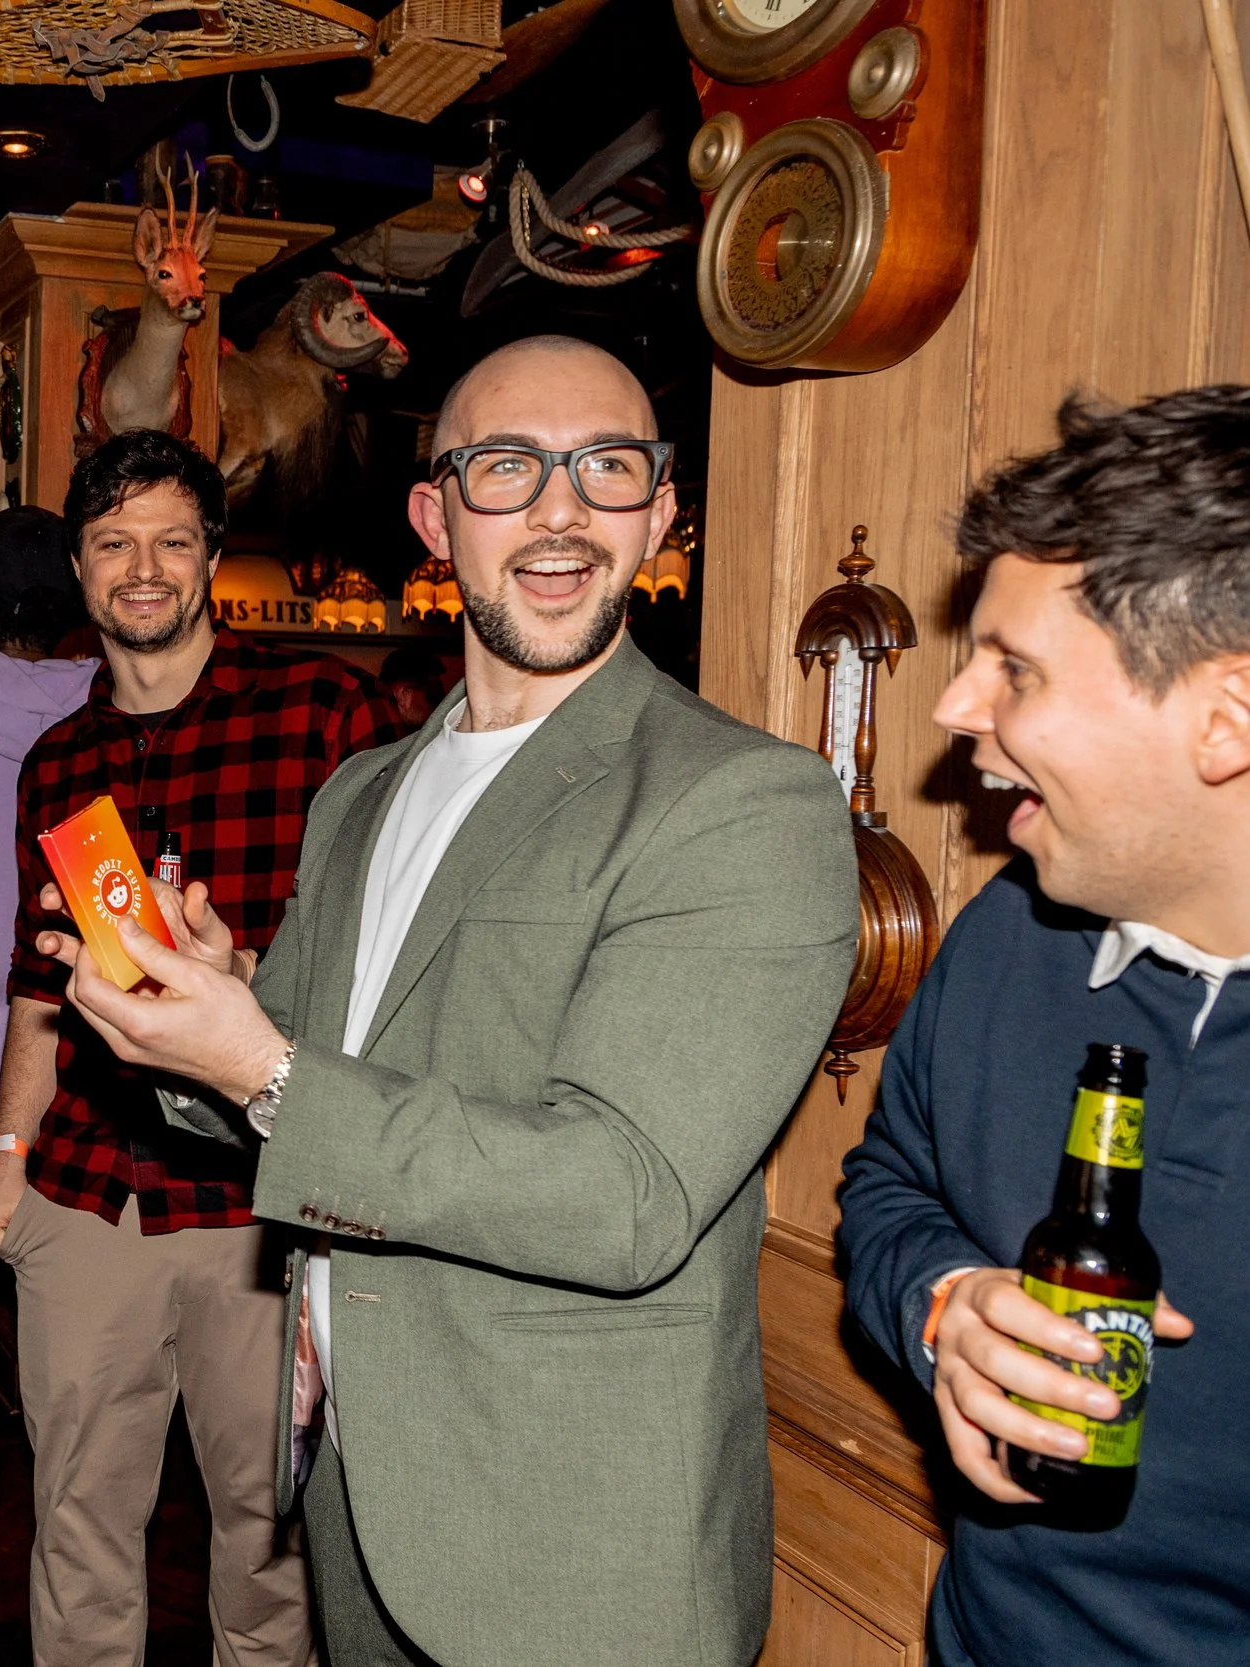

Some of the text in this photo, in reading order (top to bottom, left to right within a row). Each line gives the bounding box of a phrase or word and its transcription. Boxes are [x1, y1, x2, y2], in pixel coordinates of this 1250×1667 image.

[210, 599, 312, 624] ONS-LITS
[92, 858, 142, 928] REDDIT FUTURE LLERS
